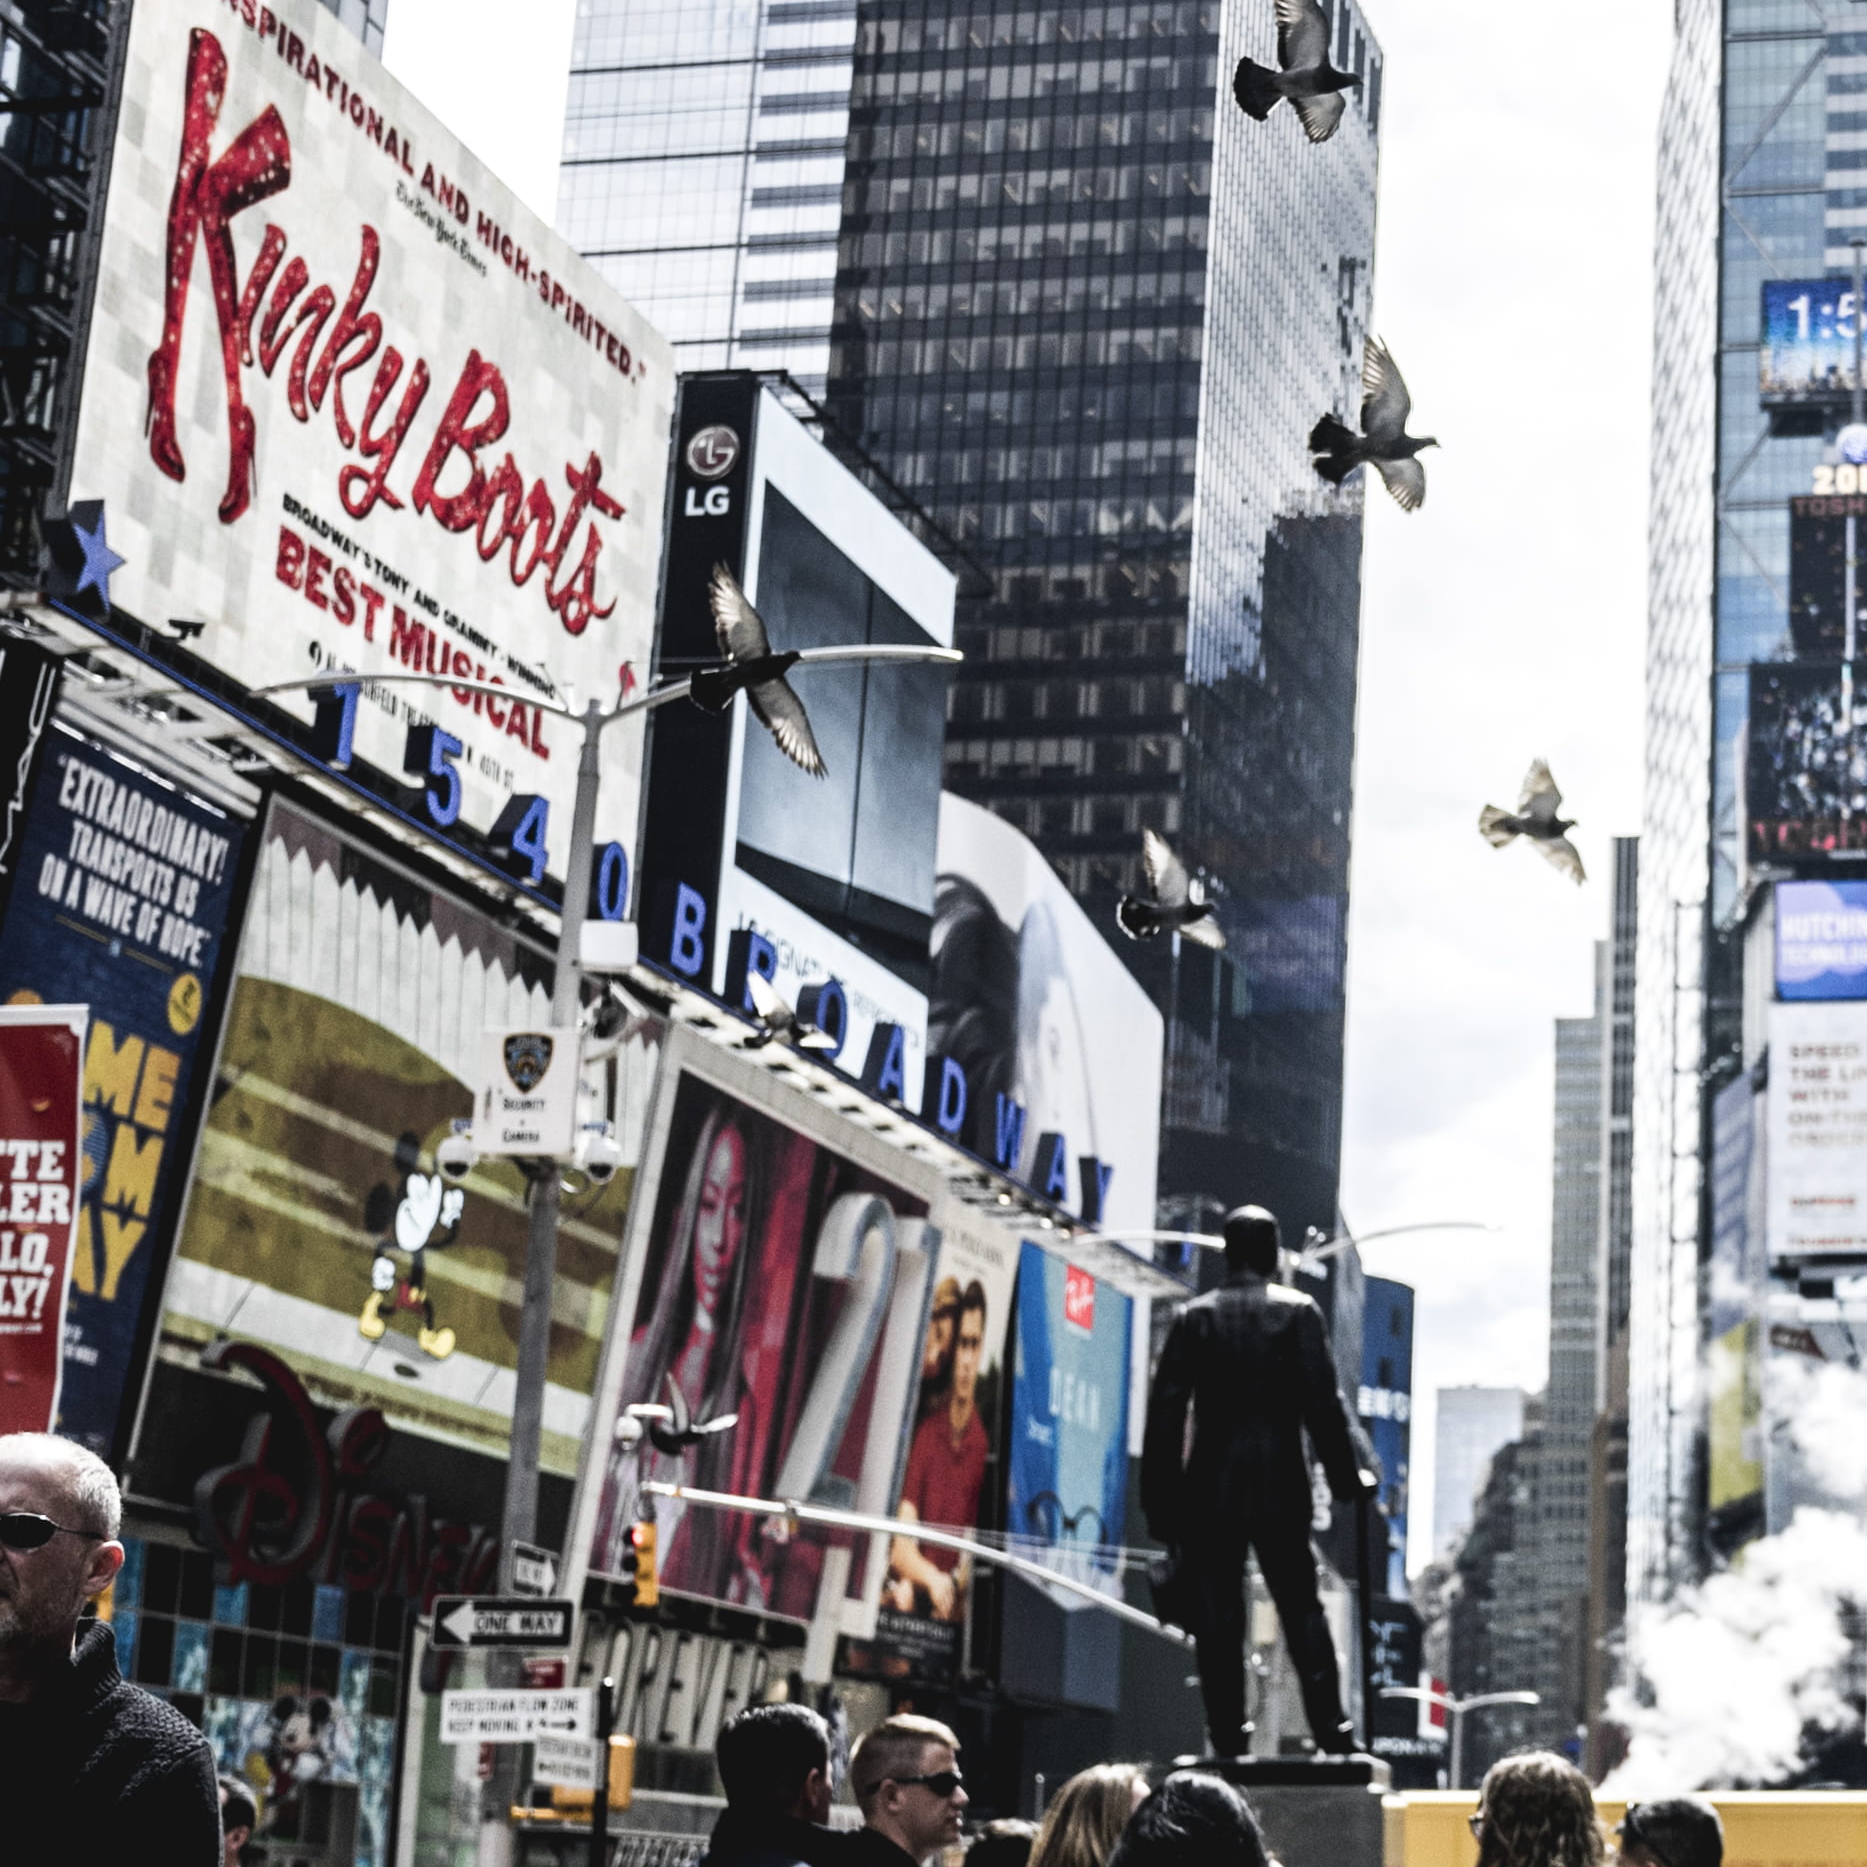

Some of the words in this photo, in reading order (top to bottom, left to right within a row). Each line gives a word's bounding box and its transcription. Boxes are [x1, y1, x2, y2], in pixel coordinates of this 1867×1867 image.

[420, 163, 470, 225] AND
[144, 27, 406, 524] Kinky
[411, 348, 627, 636] Boots
[684, 485, 731, 518] LG
[275, 524, 385, 644] BEST
[388, 604, 550, 762] MUSICAL
[413, 589, 439, 618] AND
[38, 852, 68, 903] ON
[64, 867, 83, 911] A
[83, 874, 138, 937] WAVE
[135, 900, 162, 947] OF
[69, 817, 176, 907] TRANSPORTS
[174, 873, 200, 920] US
[328, 681, 629, 922] 1540
[669, 880, 1114, 1226] BROADWAY
[474, 1610, 512, 1633] ONE
[519, 1610, 560, 1633] WAY
